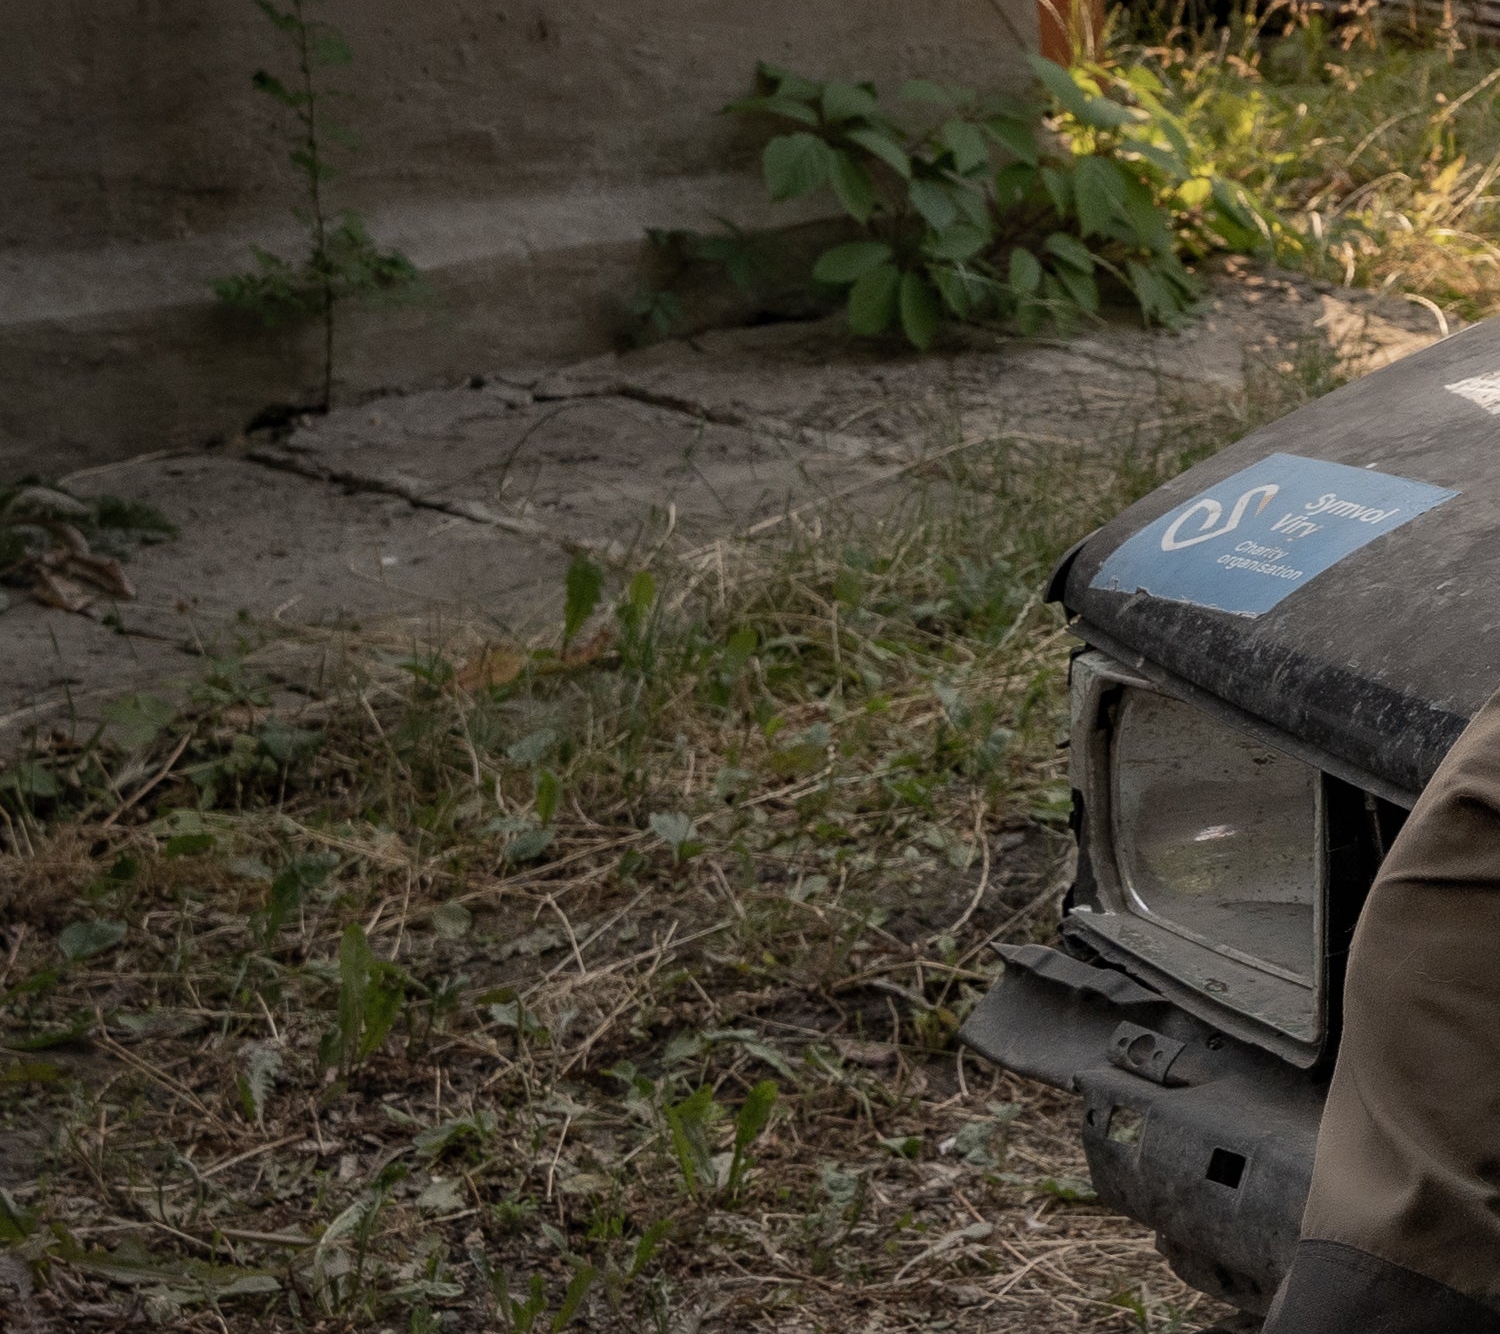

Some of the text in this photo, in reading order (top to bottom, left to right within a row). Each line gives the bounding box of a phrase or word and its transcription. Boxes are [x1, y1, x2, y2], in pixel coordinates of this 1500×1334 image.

[1305, 493, 1400, 525] Symvol
[1270, 512, 1323, 541] Viry
[1235, 540, 1289, 561] Charity
[1217, 553, 1304, 581] organisation
